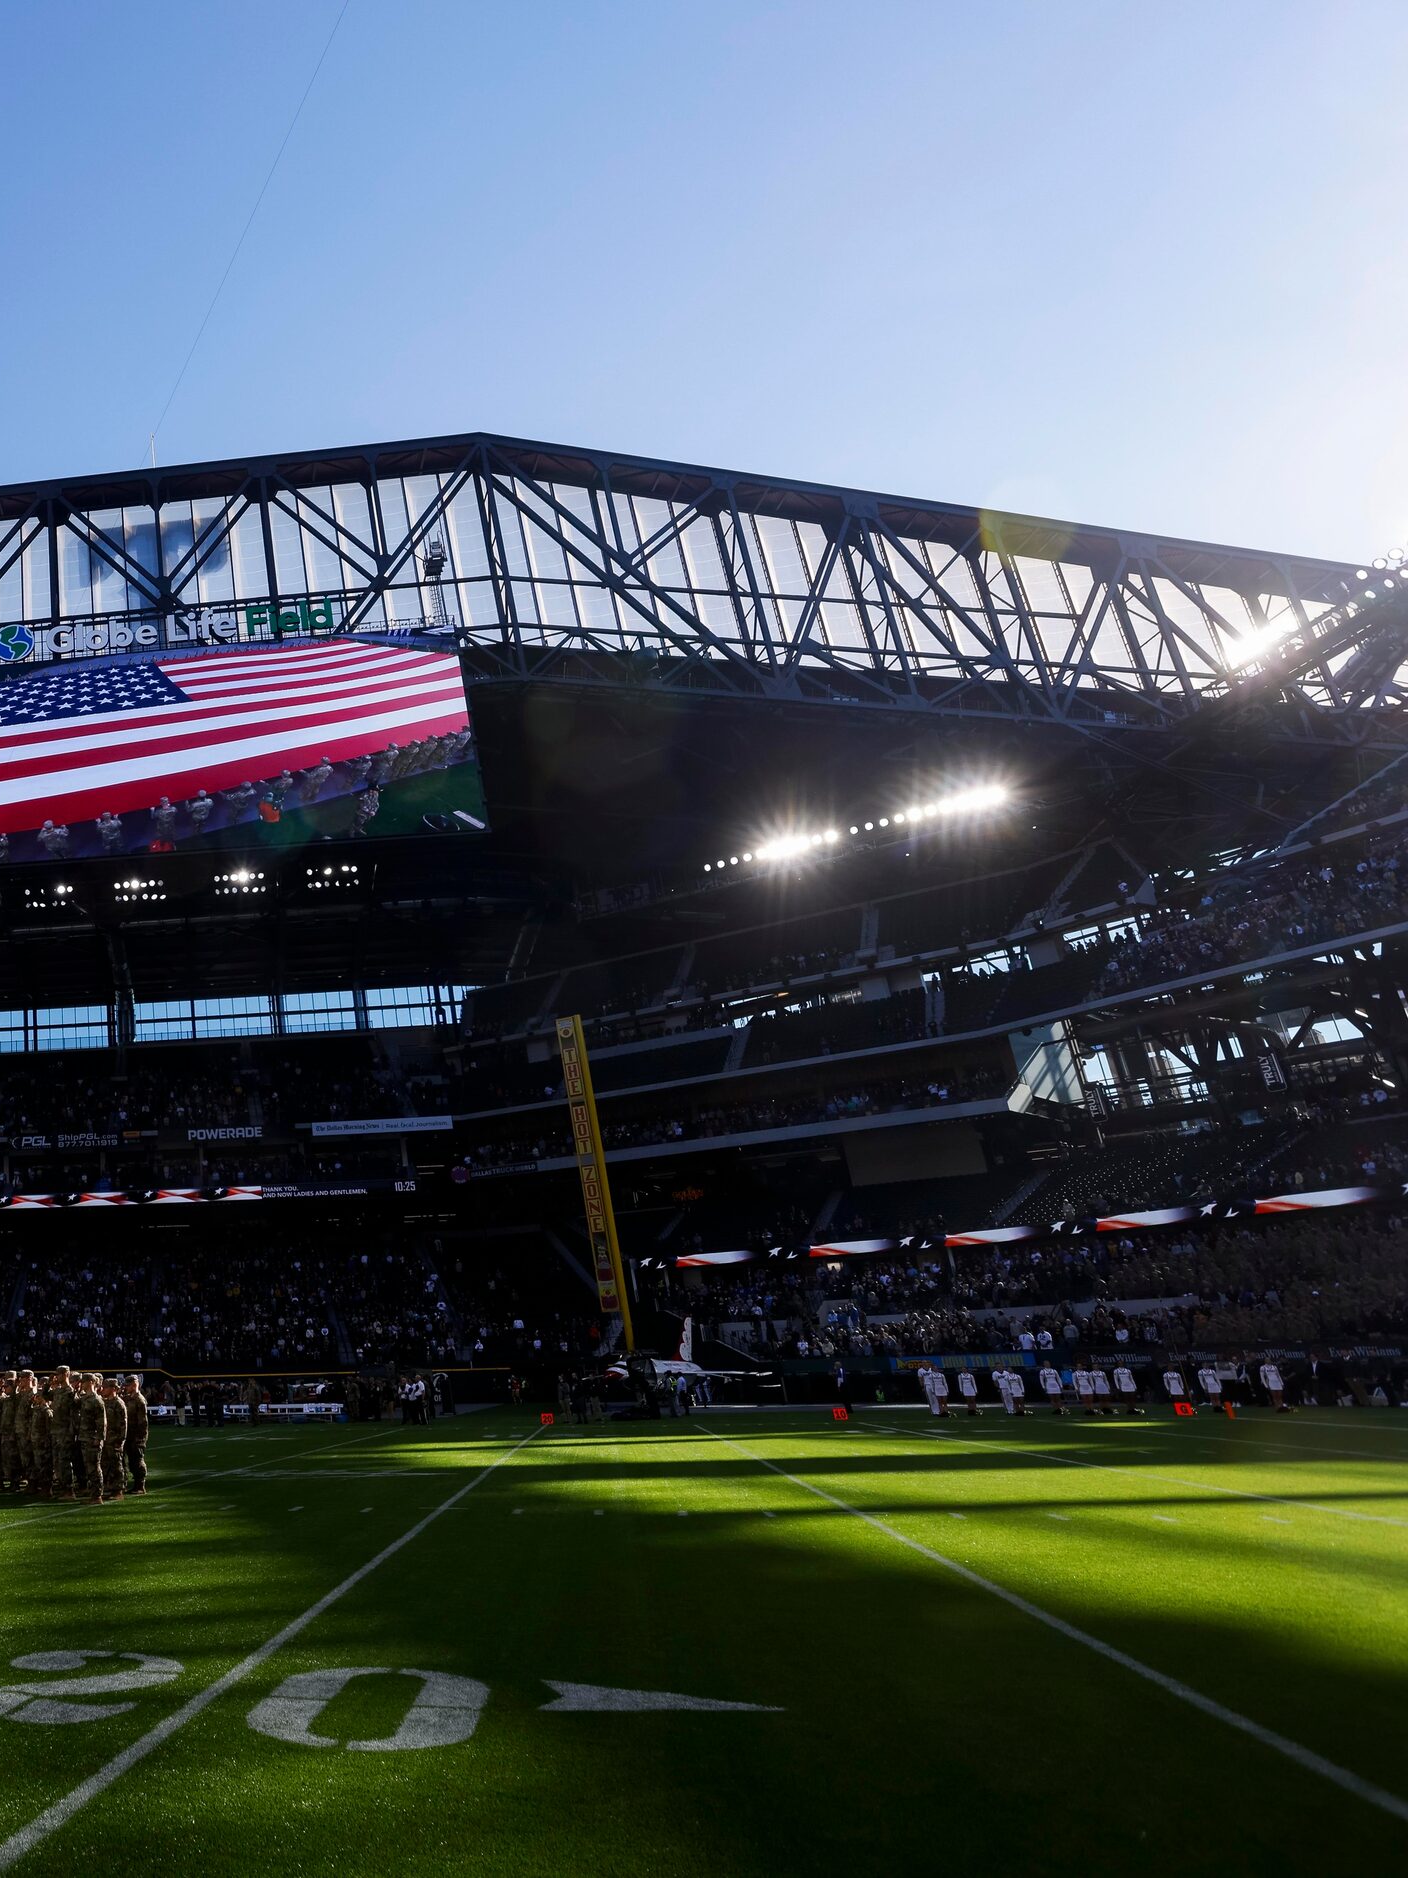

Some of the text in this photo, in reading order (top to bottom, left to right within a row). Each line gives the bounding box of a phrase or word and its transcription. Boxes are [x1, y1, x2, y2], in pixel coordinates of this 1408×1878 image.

[45, 598, 334, 654] Globe Life Field
[1257, 1055, 1276, 1086] TRULY
[1084, 1089, 1099, 1118] TRULY
[21, 1135, 51, 1147] PGL
[187, 1126, 263, 1141] POWERADE
[565, 1049, 580, 1094] THE
[574, 1107, 590, 1153] HOT
[583, 1167, 603, 1232] ZONE
[394, 1181, 416, 1192] 10:25
